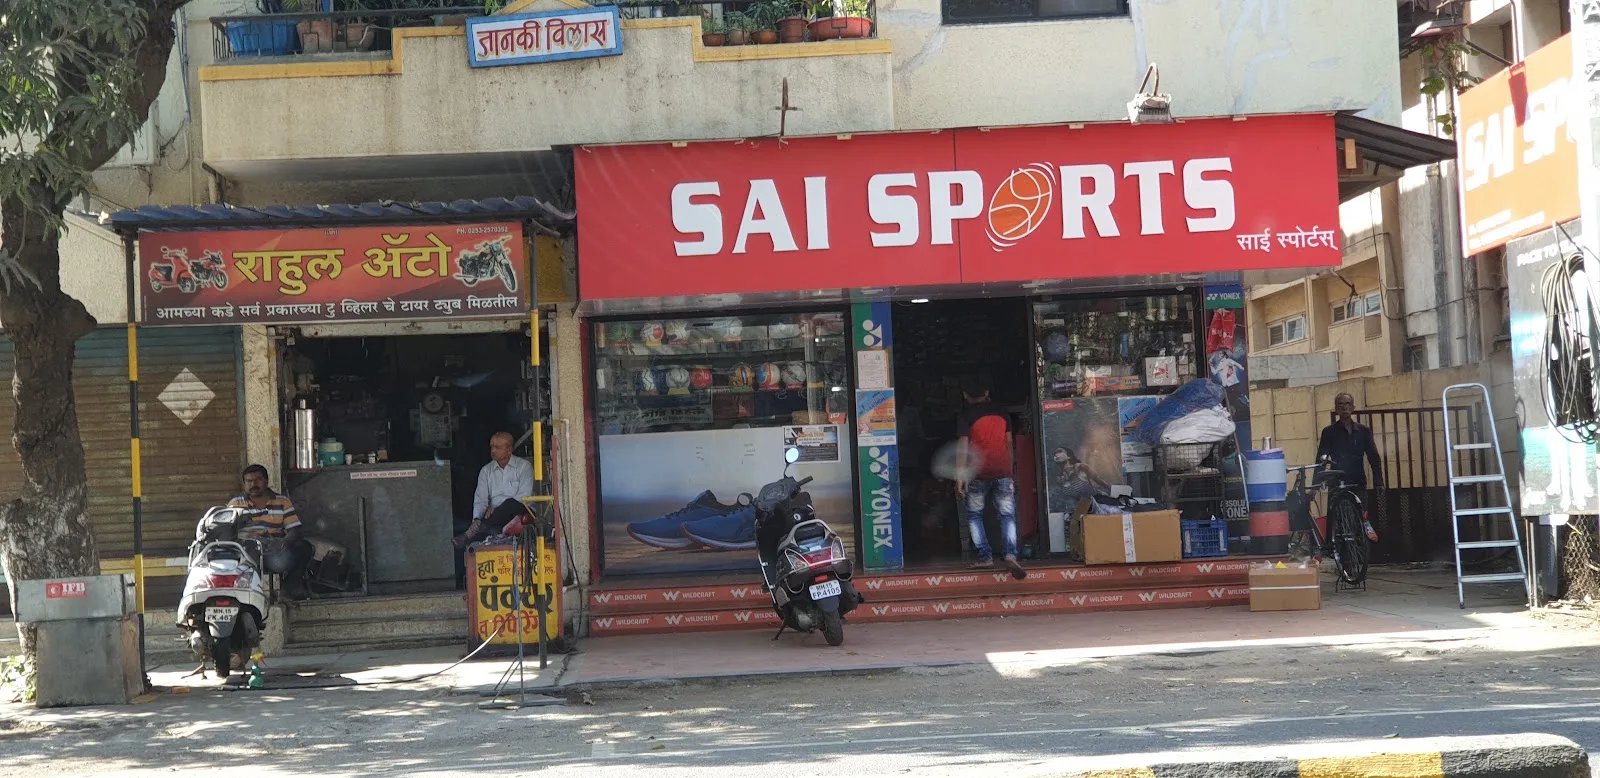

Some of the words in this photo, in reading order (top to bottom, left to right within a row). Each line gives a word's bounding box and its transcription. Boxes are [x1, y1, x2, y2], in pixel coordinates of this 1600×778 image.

[671, 176, 830, 257] SAI
[867, 157, 1236, 252] SPORTS
[1236, 227, 1271, 253] साई
[1276, 225, 1339, 250] स्पोर्टस्
[232, 248, 345, 295] राहुल
[1219, 292, 1241, 301] YONEX
[156, 306, 206, 319] आमच्या
[210, 302, 235, 318] कडे
[239, 301, 261, 317] सर्व
[265, 302, 321, 317] प्रकारच्या
[341, 298, 378, 315] व्हिलर
[382, 297, 395, 313] चे
[400, 299, 431, 312] टायर
[433, 298, 462, 315] ट्युब
[466, 294, 518, 309] मिळतील
[871, 486, 893, 548] YONEX
[478, 559, 495, 580] हवा
[1216, 563, 1249, 571] WILDCRAFT
[1027, 572, 1046, 580] CRAFT
[1079, 569, 1114, 577] WILDCRAFT
[885, 579, 918, 587] WILDCRAFT
[944, 575, 978, 583] WILDCRAFT
[62, 582, 86, 593] IFB
[614, 593, 648, 601] WILDCRAFT
[682, 591, 716, 599] WILDCRAFT
[1089, 595, 1123, 603] WILDCRAFT
[1158, 591, 1193, 599] WILDCRAFT
[952, 602, 986, 610] WILDCRAFT
[1020, 598, 1054, 606] WILDCRAFT
[891, 605, 925, 613] WILDCRAFT
[684, 615, 719, 623] WILDCRAFT
